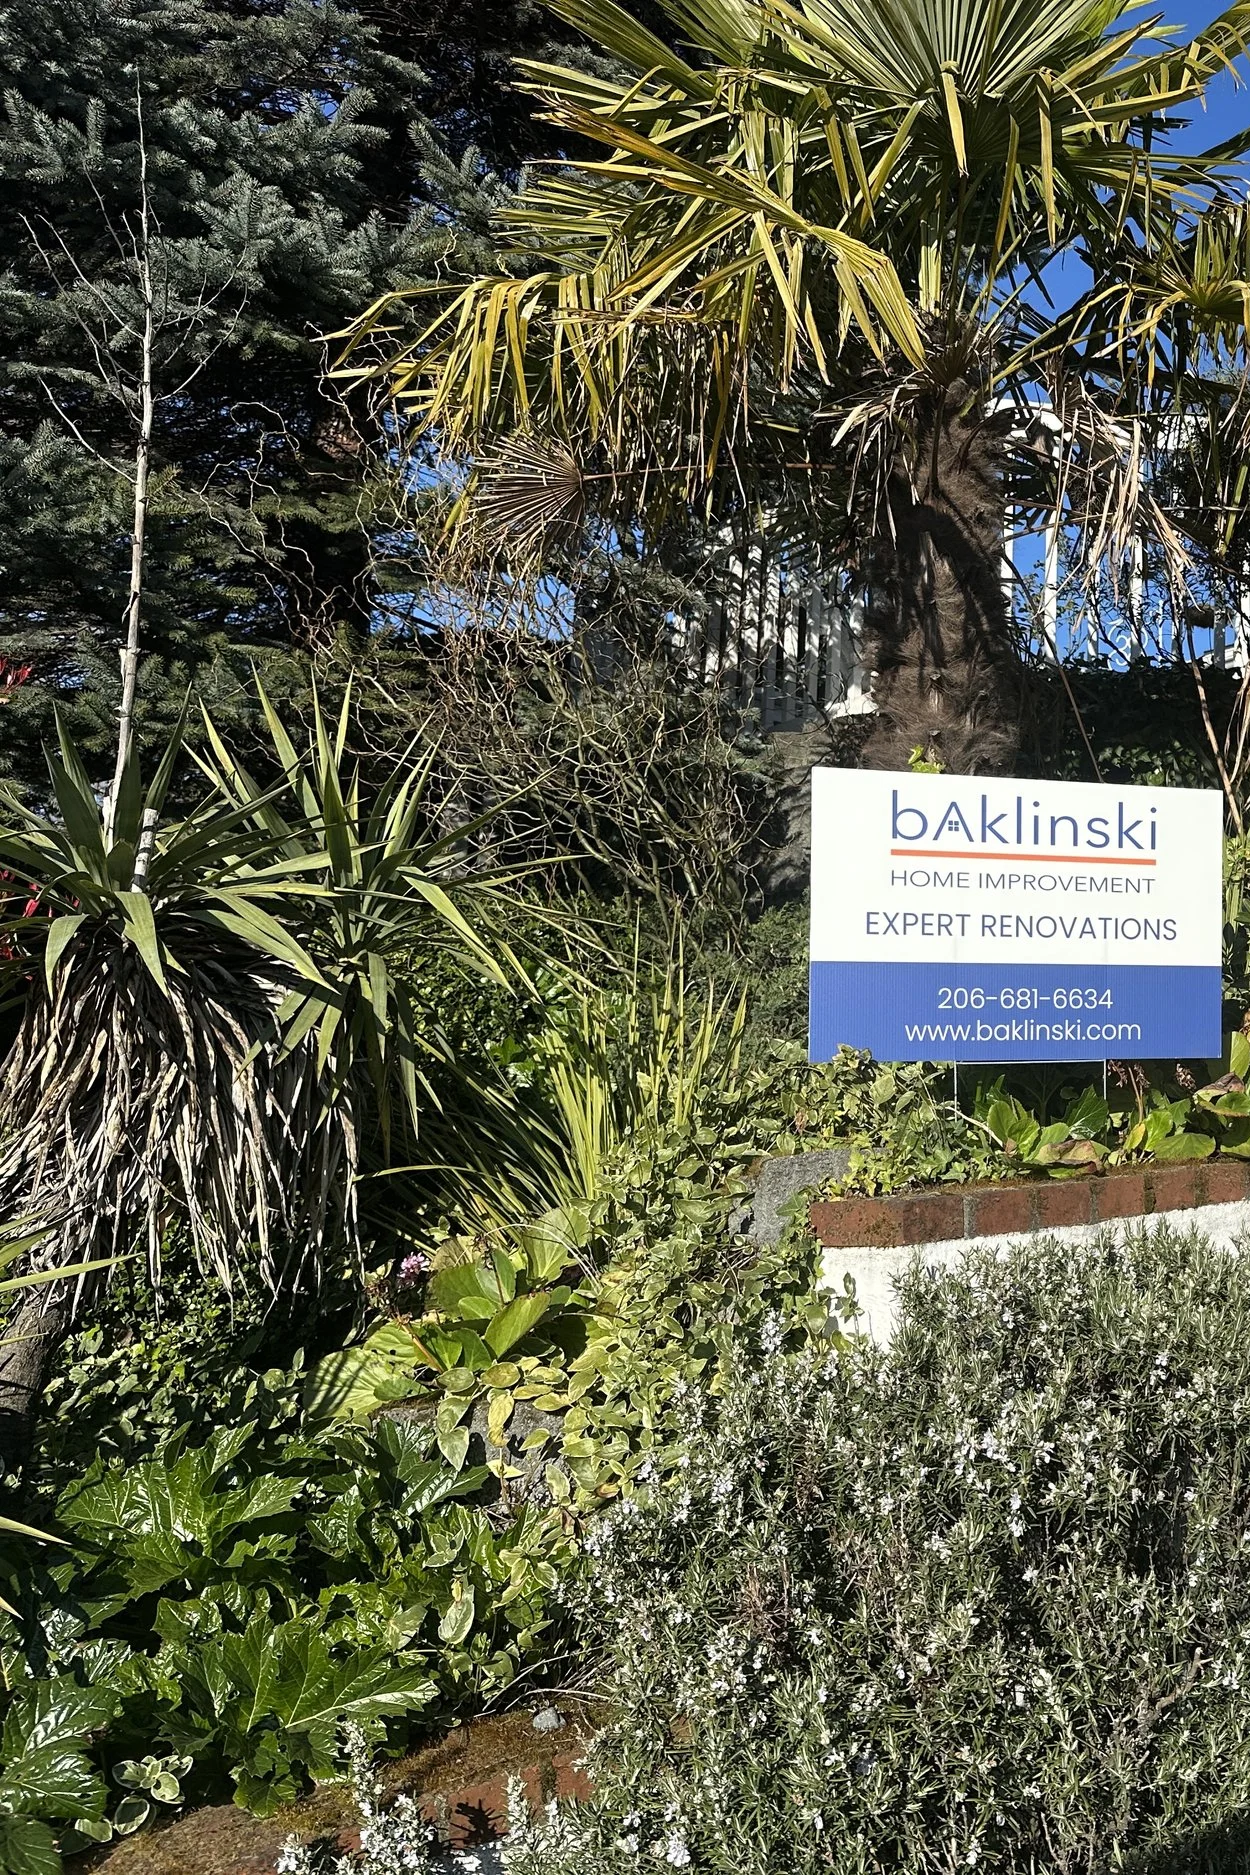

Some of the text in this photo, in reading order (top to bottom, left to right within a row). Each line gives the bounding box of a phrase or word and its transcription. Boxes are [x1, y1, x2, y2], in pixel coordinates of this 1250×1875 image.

[892, 789, 1157, 850] bAklinski
[890, 869, 1156, 894] HOME IMPROVEMENT
[866, 911, 1178, 941] EXPERT RENOVATIONS
[937, 987, 1114, 1010] 206-681-6634
[904, 1019, 1141, 1042] www.baklinski.com
